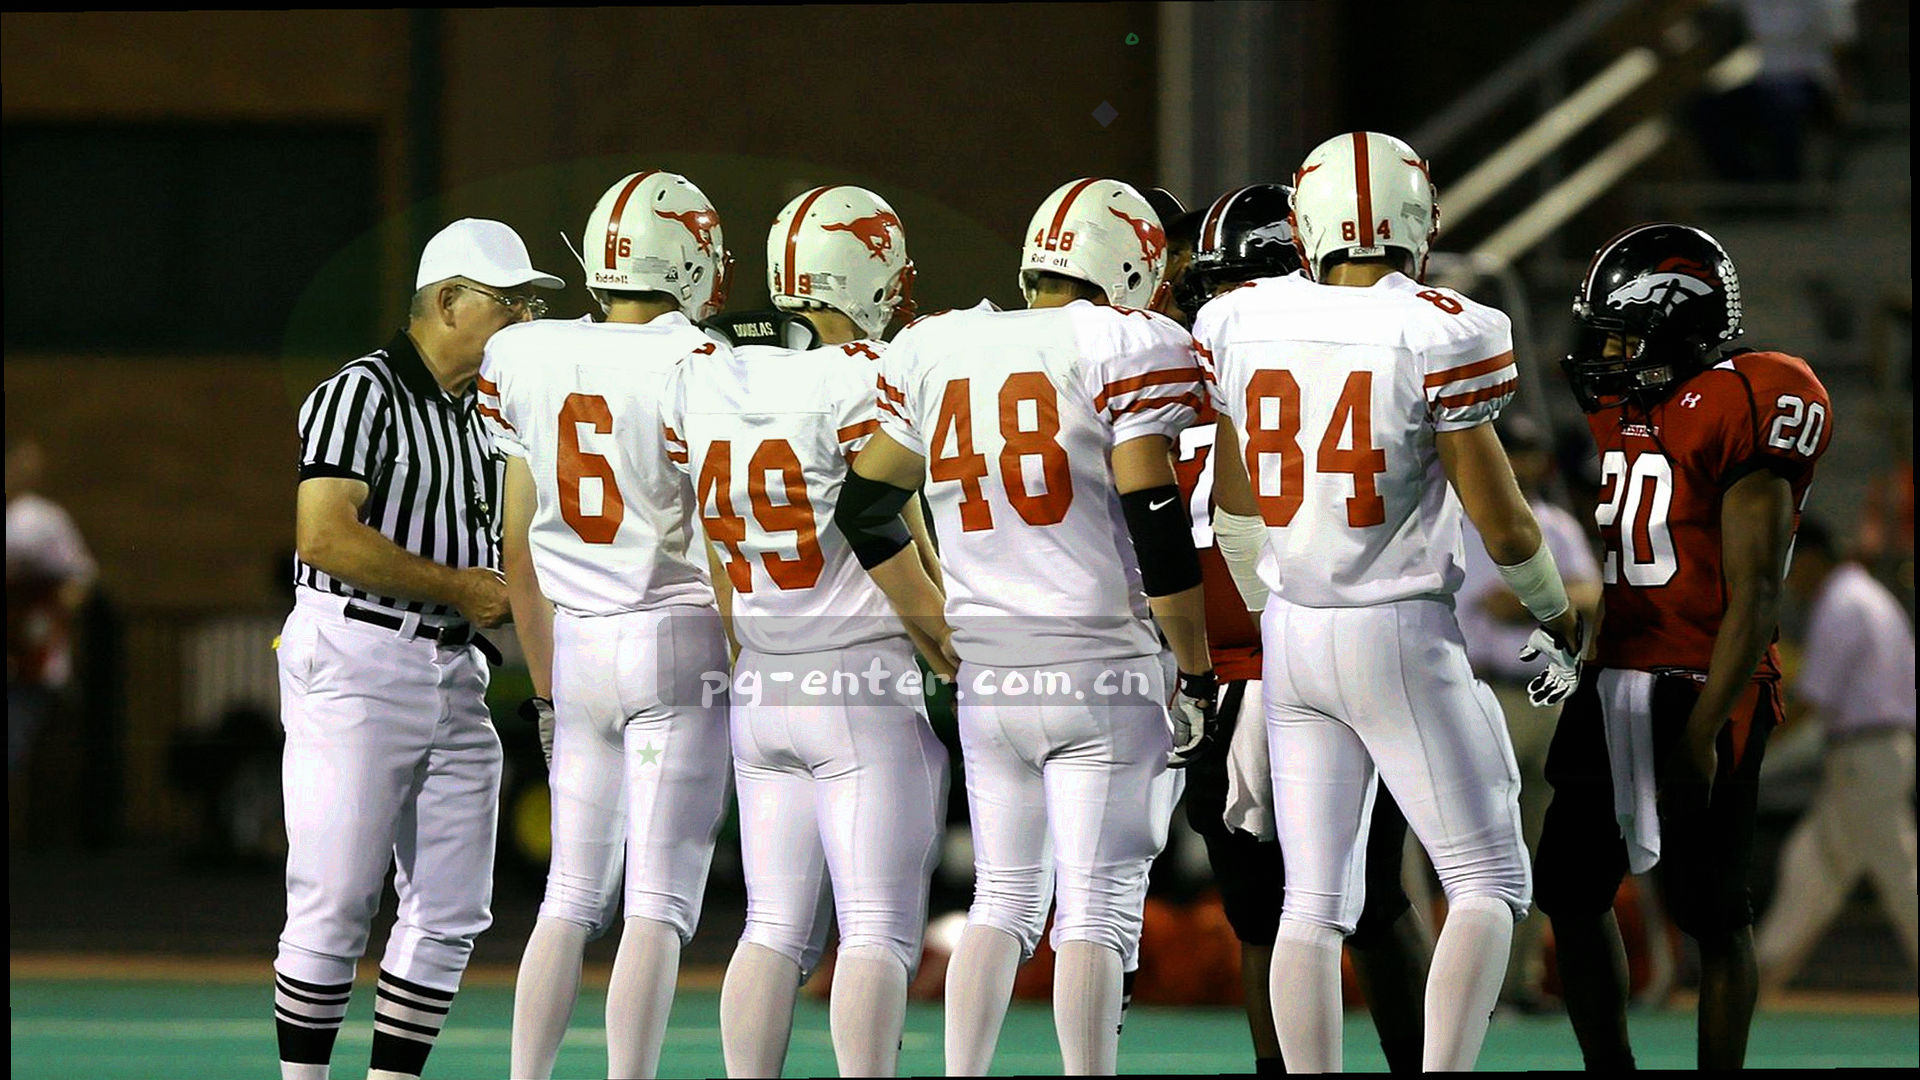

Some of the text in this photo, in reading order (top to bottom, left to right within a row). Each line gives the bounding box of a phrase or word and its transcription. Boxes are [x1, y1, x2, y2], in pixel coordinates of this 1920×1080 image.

[618, 237, 631, 258] 6
[732, 321, 775, 338] DOUGLAS
[556, 392, 624, 545] 6
[929, 370, 1074, 533] 48
[1245, 368, 1387, 528] 84
[1767, 393, 1826, 458] 20
[699, 438, 826, 594] 49
[1594, 450, 1678, 587] 20
